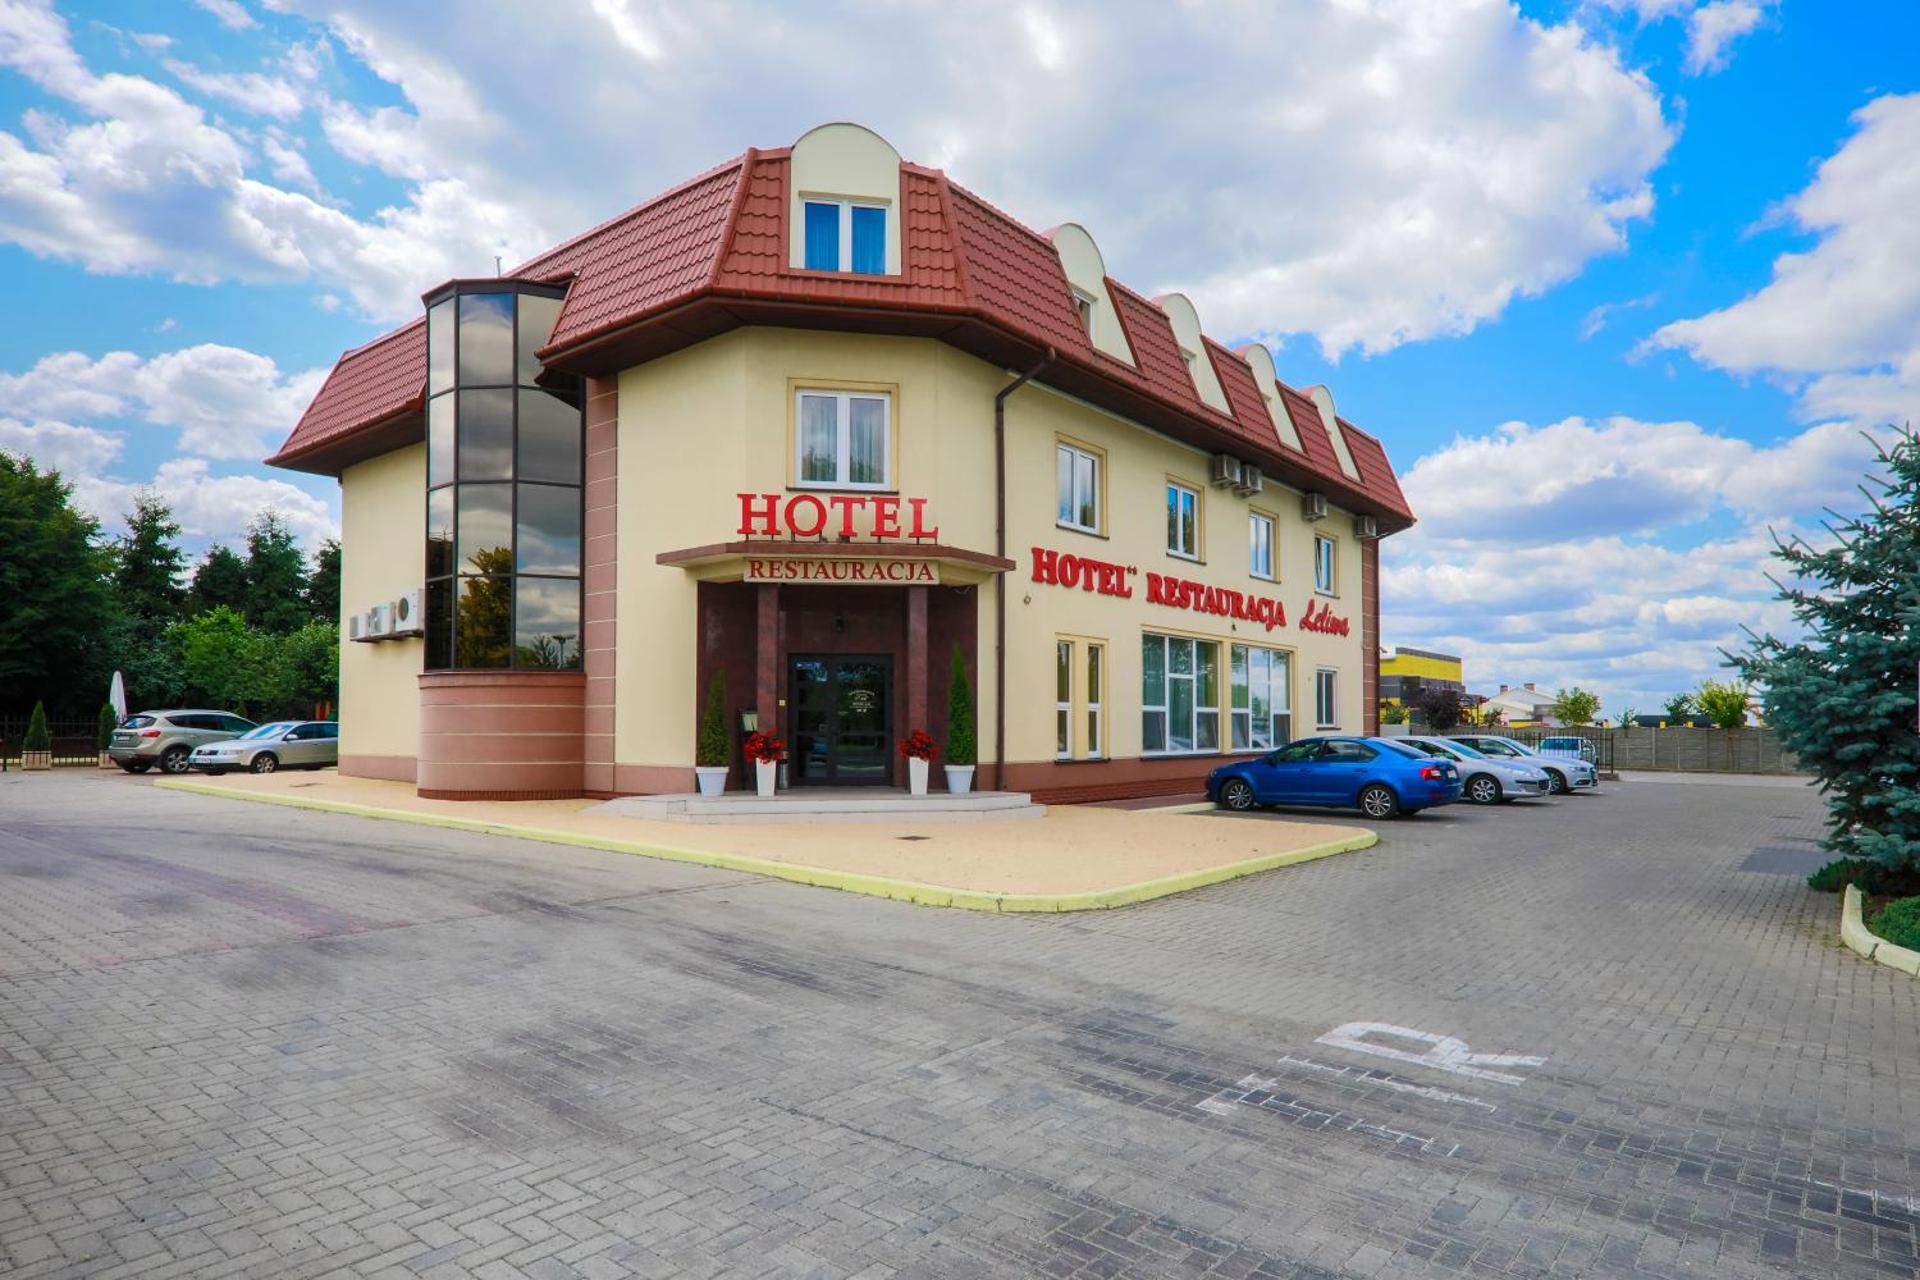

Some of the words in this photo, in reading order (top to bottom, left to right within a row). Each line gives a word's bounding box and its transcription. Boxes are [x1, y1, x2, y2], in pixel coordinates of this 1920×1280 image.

[736, 493, 939, 538] HOTEL
[749, 559, 935, 581] RESTAURACJA
[1031, 547, 1132, 598] HOTEL
[1146, 572, 1287, 632] RESTAURACJA
